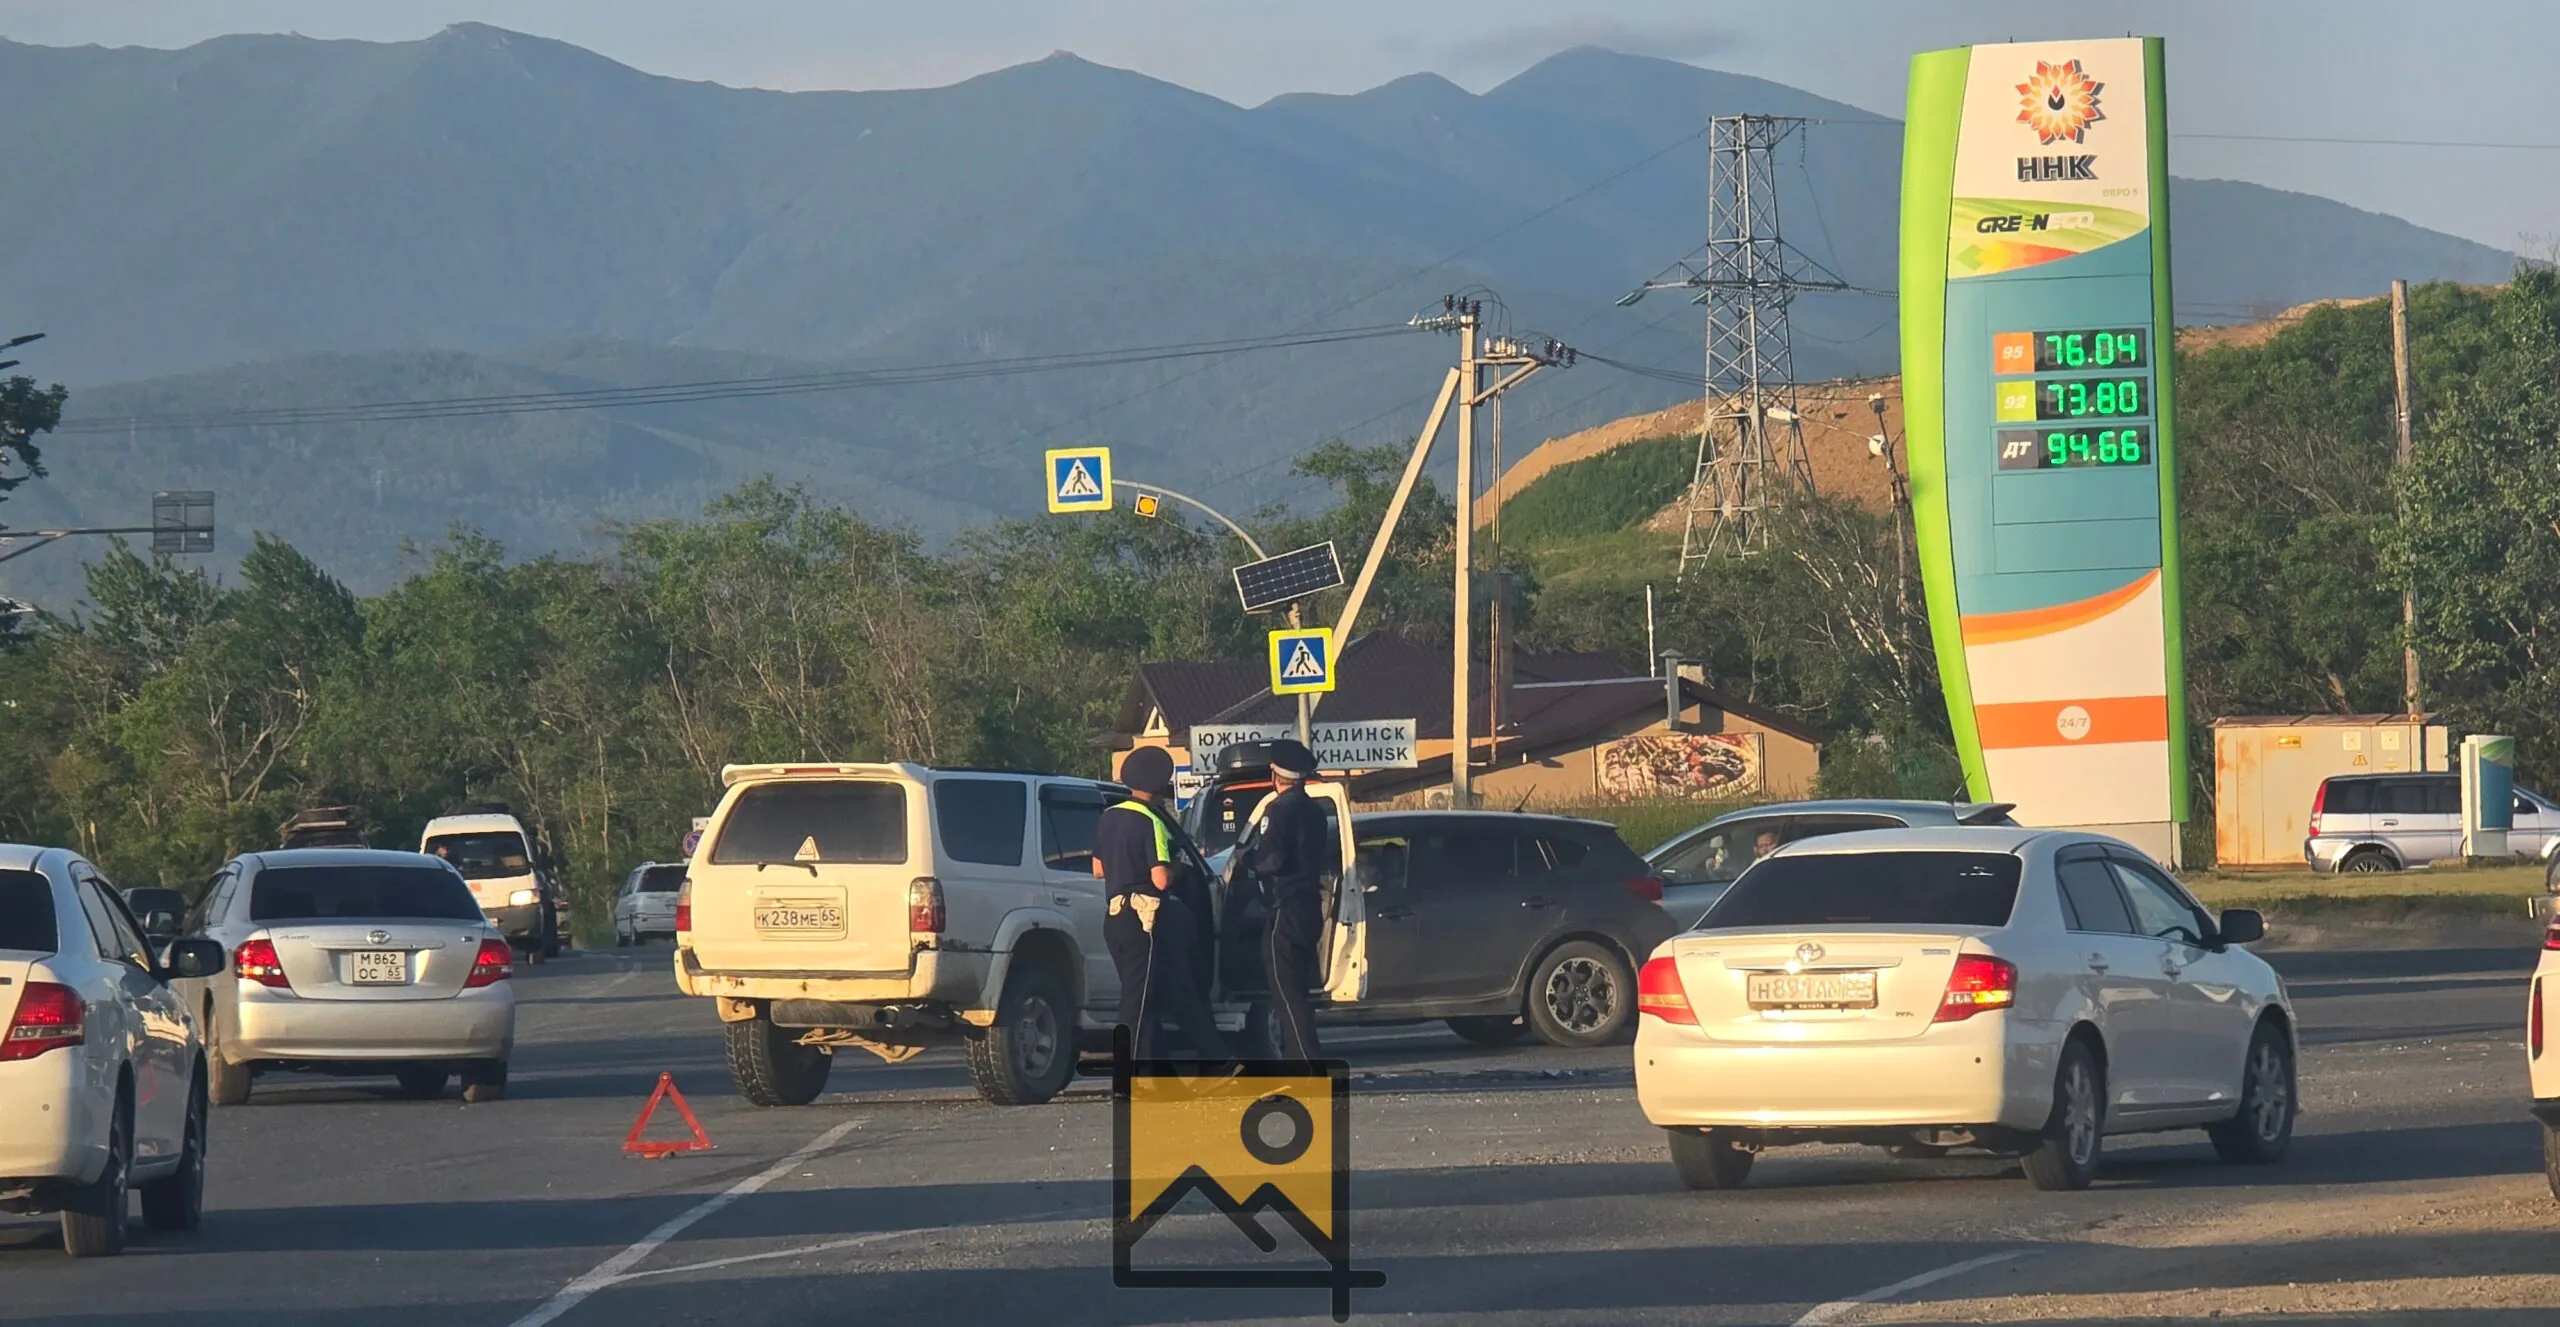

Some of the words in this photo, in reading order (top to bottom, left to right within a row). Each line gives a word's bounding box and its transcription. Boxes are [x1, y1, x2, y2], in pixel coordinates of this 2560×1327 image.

[2017, 154, 2098, 182] ННК
[2002, 345, 2024, 360] 95
[2046, 333, 2136, 366] 76.04
[2004, 395, 2027, 409] 92
[2047, 381, 2138, 416] 73.80
[2002, 440, 2032, 460] ДТ
[2047, 430, 2140, 464] 94.66
[1281, 726, 1405, 743] СХАЛИНСК
[2059, 717, 2087, 728] 24/7
[1316, 747, 1408, 764] KHALINSK
